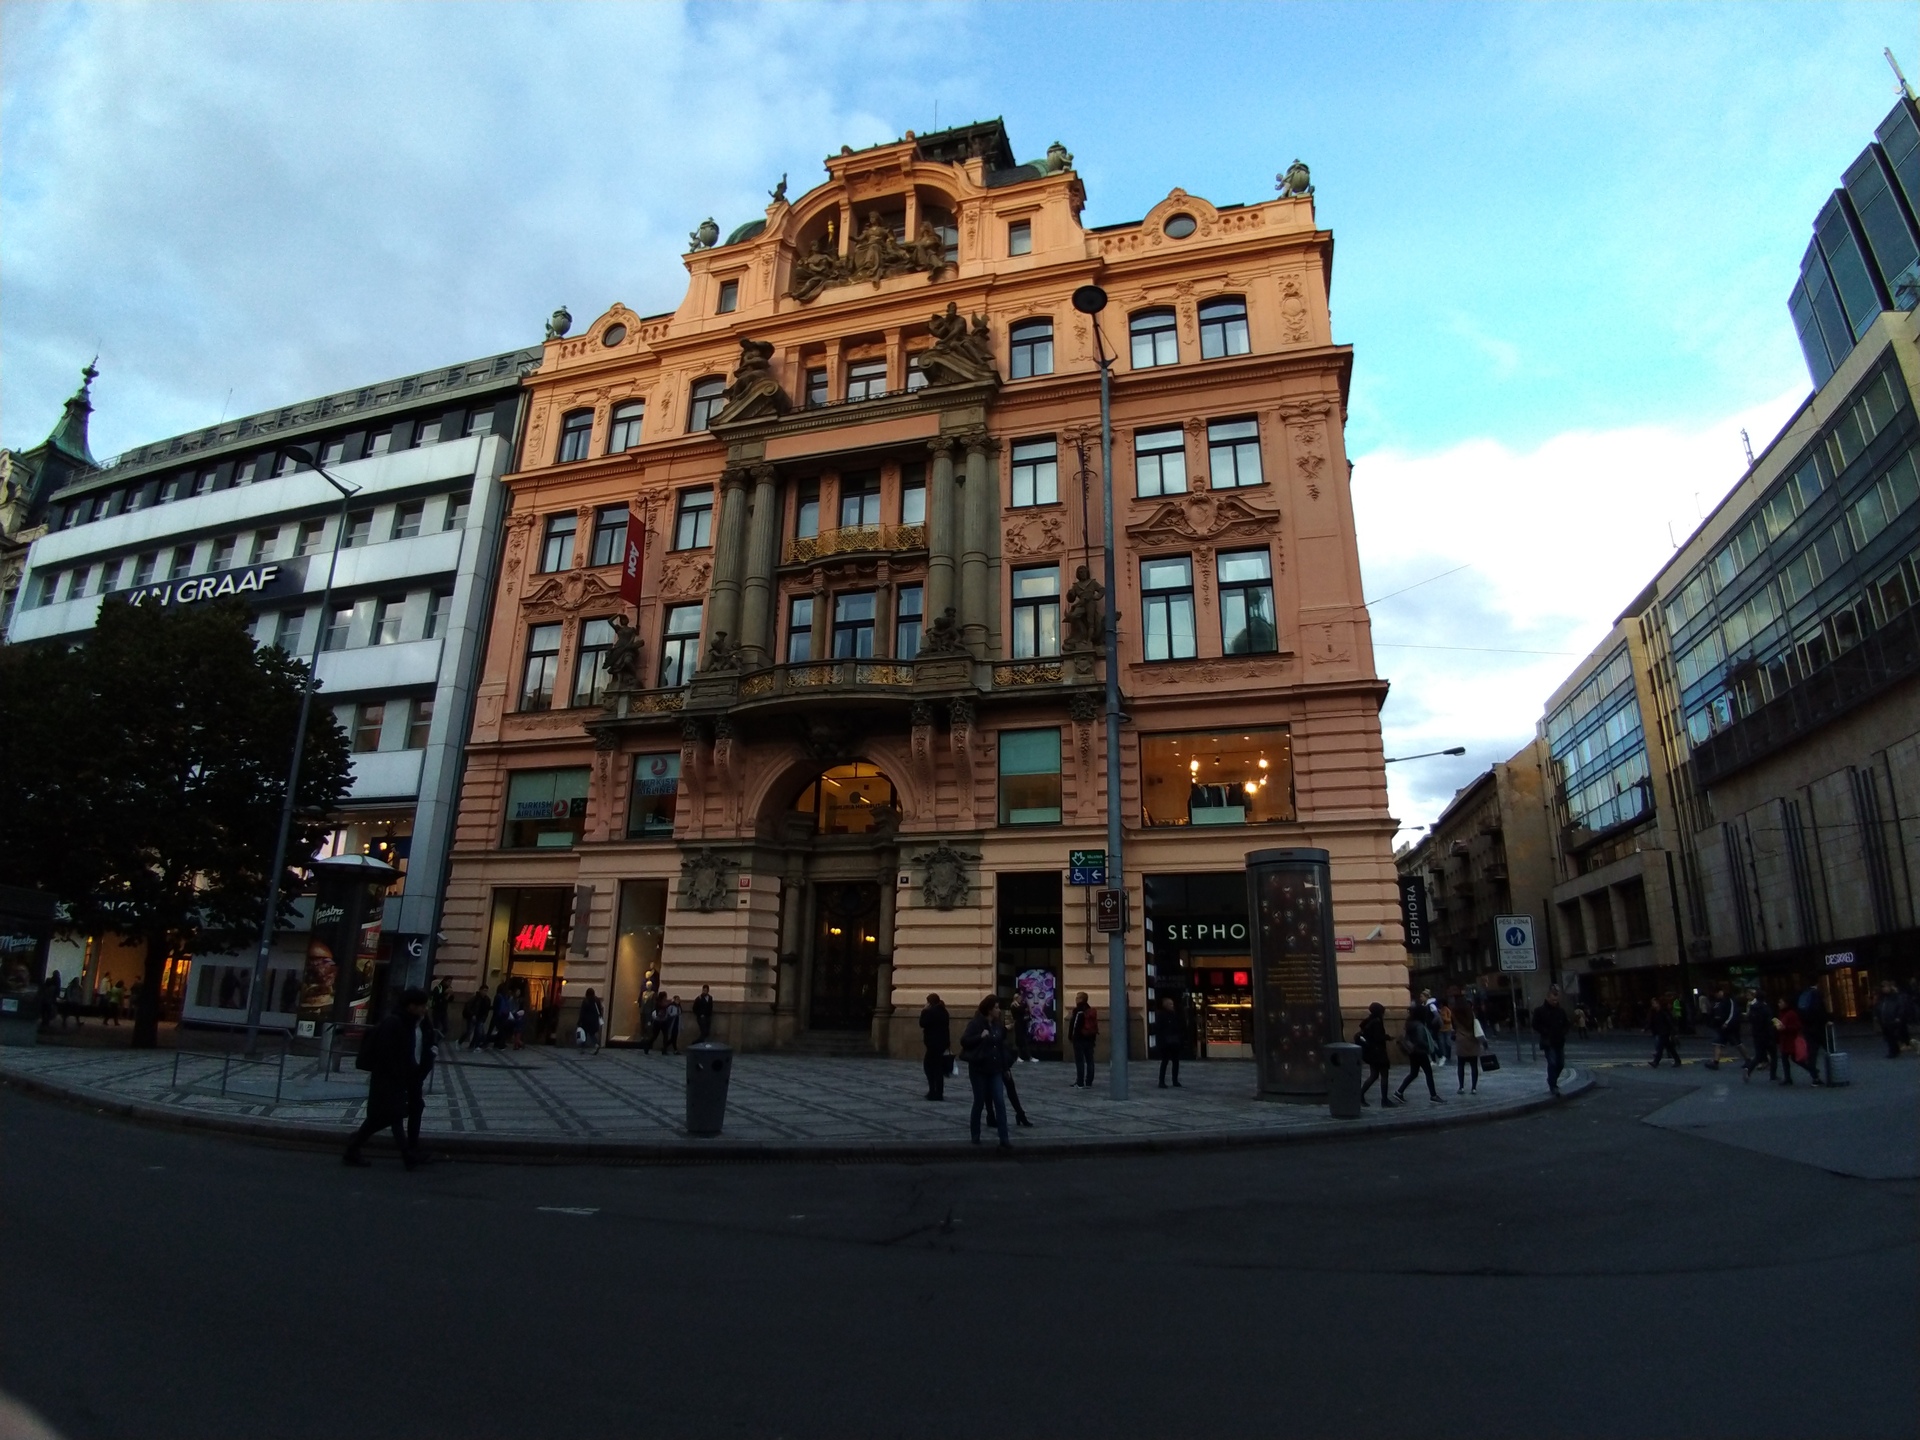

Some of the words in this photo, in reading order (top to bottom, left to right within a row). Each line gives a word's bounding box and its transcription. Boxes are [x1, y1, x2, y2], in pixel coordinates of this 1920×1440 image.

[628, 541, 639, 578] AON
[176, 565, 279, 604] GRAAF
[516, 809, 551, 818] AIRLINES
[517, 801, 551, 809] TURKISH
[1407, 884, 1420, 944] SEPHORA
[514, 924, 551, 951] H&M
[1009, 927, 1056, 935] SEPHORA
[1168, 923, 1246, 940] SEPHO
